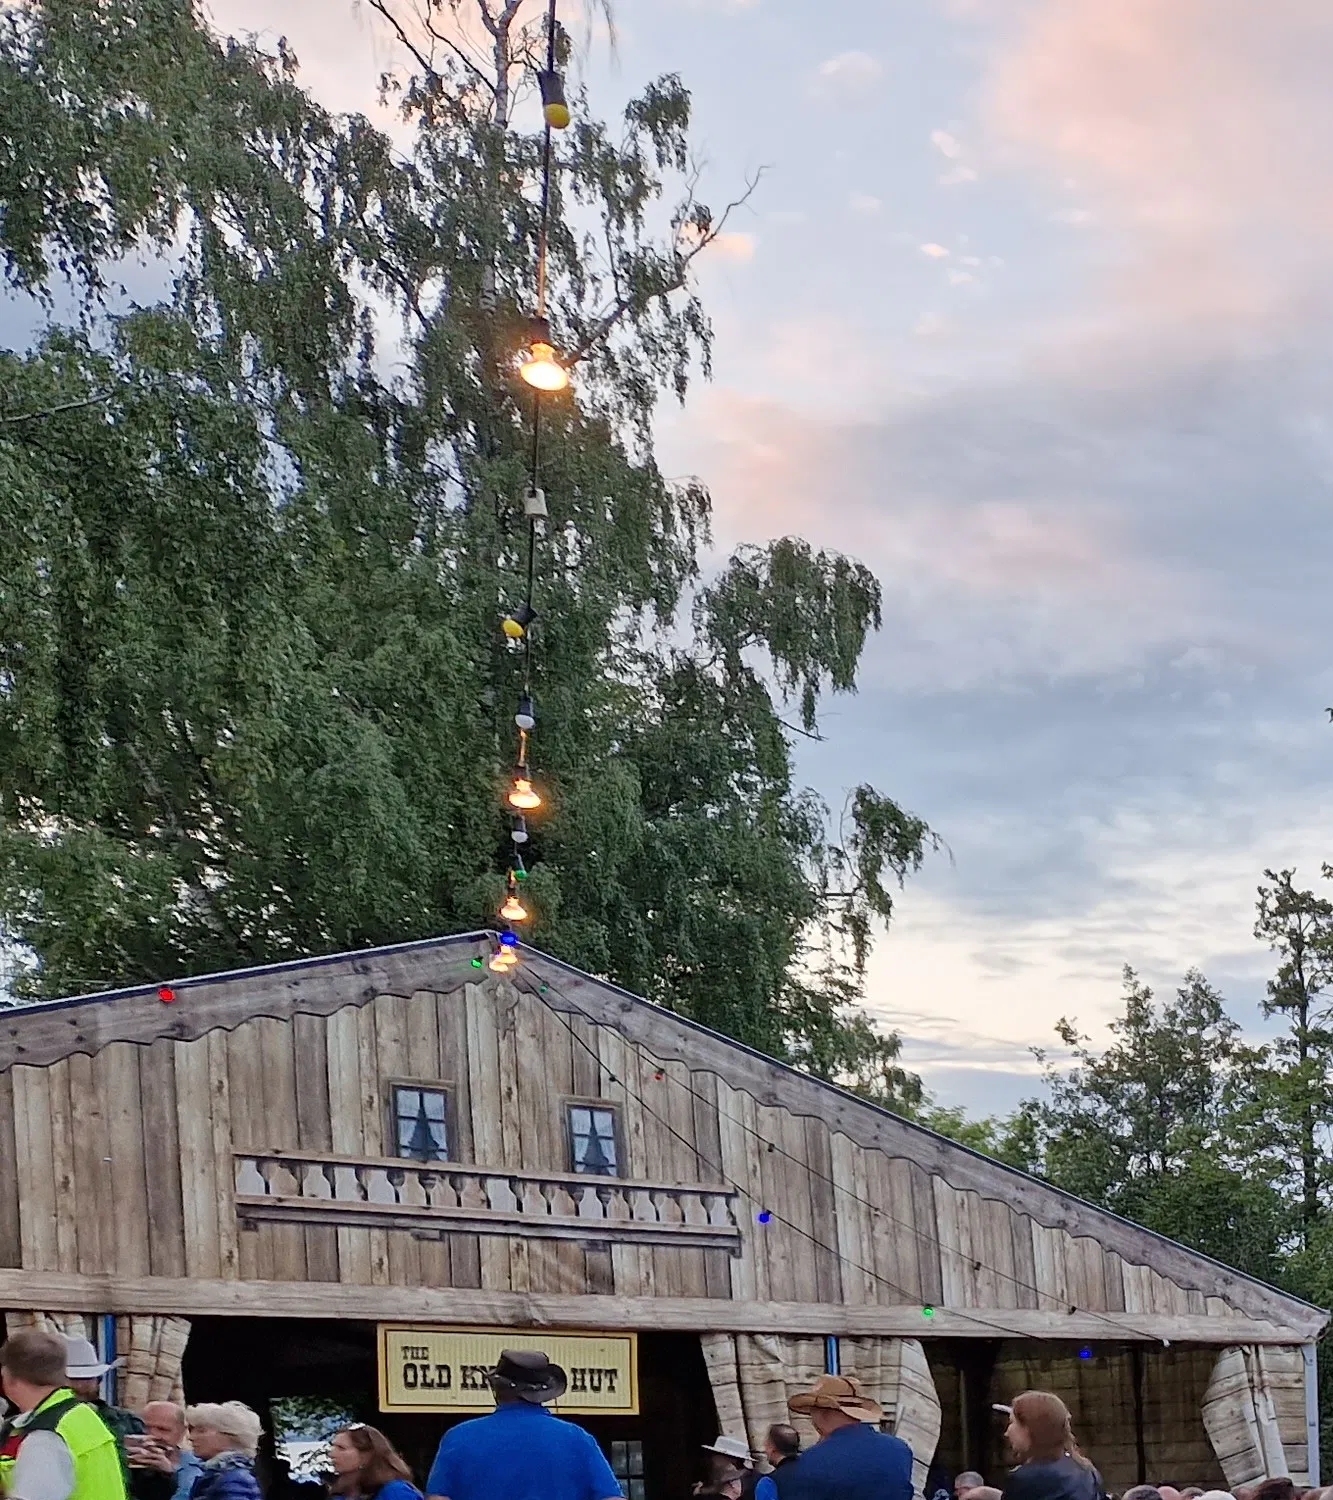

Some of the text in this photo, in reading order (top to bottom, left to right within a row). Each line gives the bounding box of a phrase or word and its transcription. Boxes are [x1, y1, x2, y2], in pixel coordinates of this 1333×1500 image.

[401, 1346, 430, 1361] THE
[403, 1363, 452, 1390] OLD
[571, 1367, 618, 1393] HUT
